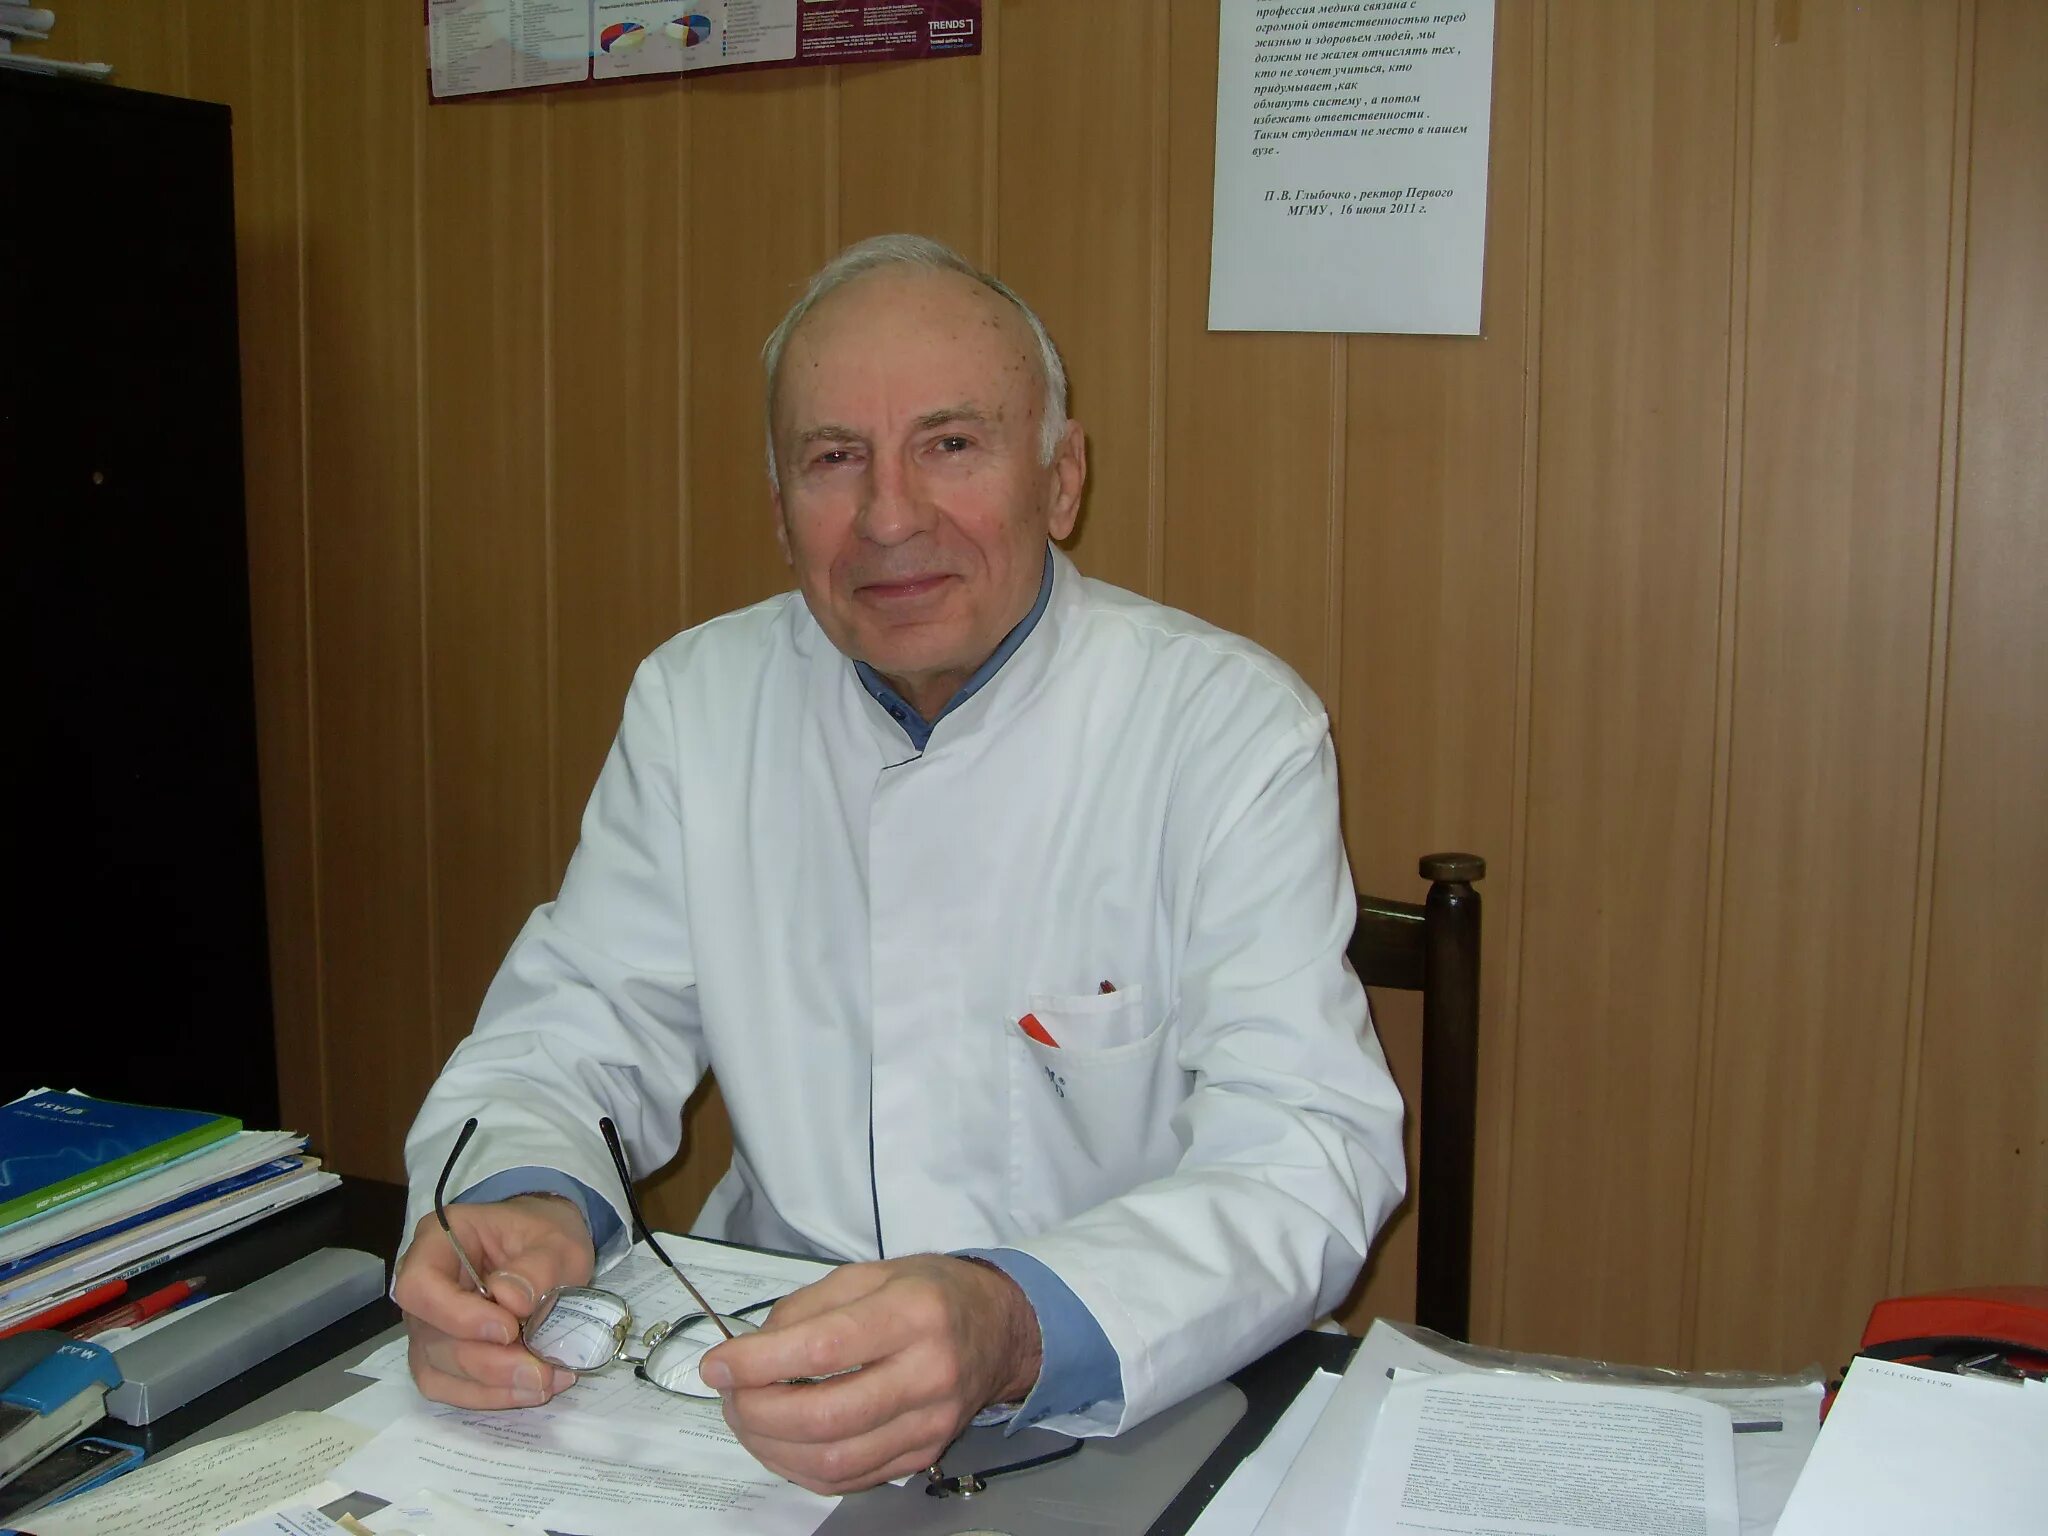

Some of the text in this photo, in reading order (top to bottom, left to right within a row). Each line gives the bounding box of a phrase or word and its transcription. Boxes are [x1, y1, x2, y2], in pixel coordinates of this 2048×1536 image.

[1255, 0, 1417, 18] профессия медика связана с
[928, 19, 966, 30] TRENDS
[1255, 11, 1467, 34] огромной ответственностью перед
[1254, 29, 1436, 48] жизнью и здоровьем людей, мы
[1254, 46, 1456, 64] должны не жалея отчислять тех
[1254, 63, 1413, 79] кто не хочет учиться, кто
[1253, 83, 1332, 97] придумывает
[1253, 95, 1421, 111] обмануть систему а потом
[1253, 111, 1425, 125] избежать ответственности
[1253, 125, 1468, 141] Таким студентам не место в нашем
[1251, 147, 1275, 158] вузе
[1294, 189, 1352, 201] Глыбочко
[1358, 190, 1403, 202] ректор
[1405, 187, 1454, 201] Первого
[1288, 202, 1427, 216] МГМУ 16 июня 2011 г.
[56, 1345, 97, 1360] MAX
